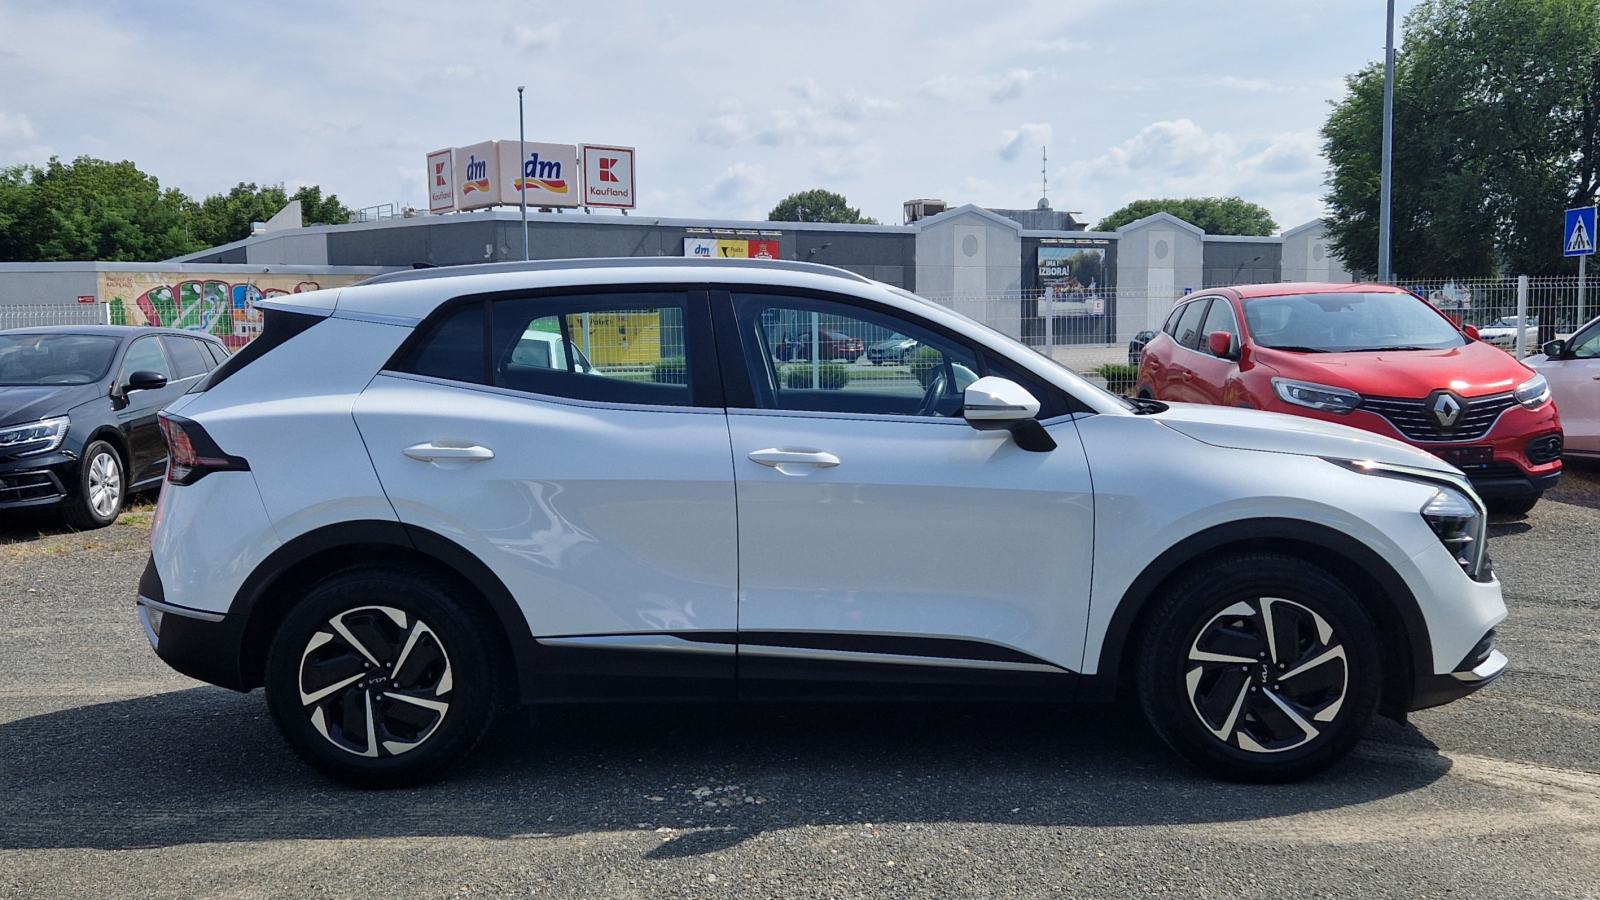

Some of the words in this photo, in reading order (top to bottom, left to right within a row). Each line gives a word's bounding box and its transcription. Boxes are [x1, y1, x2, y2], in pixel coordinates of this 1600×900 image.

[467, 155, 486, 181] dm
[524, 153, 562, 179] dm
[590, 186, 629, 197] Kaufland
[694, 244, 710, 255] dm
[1039, 265, 1070, 276] IZBORA!
